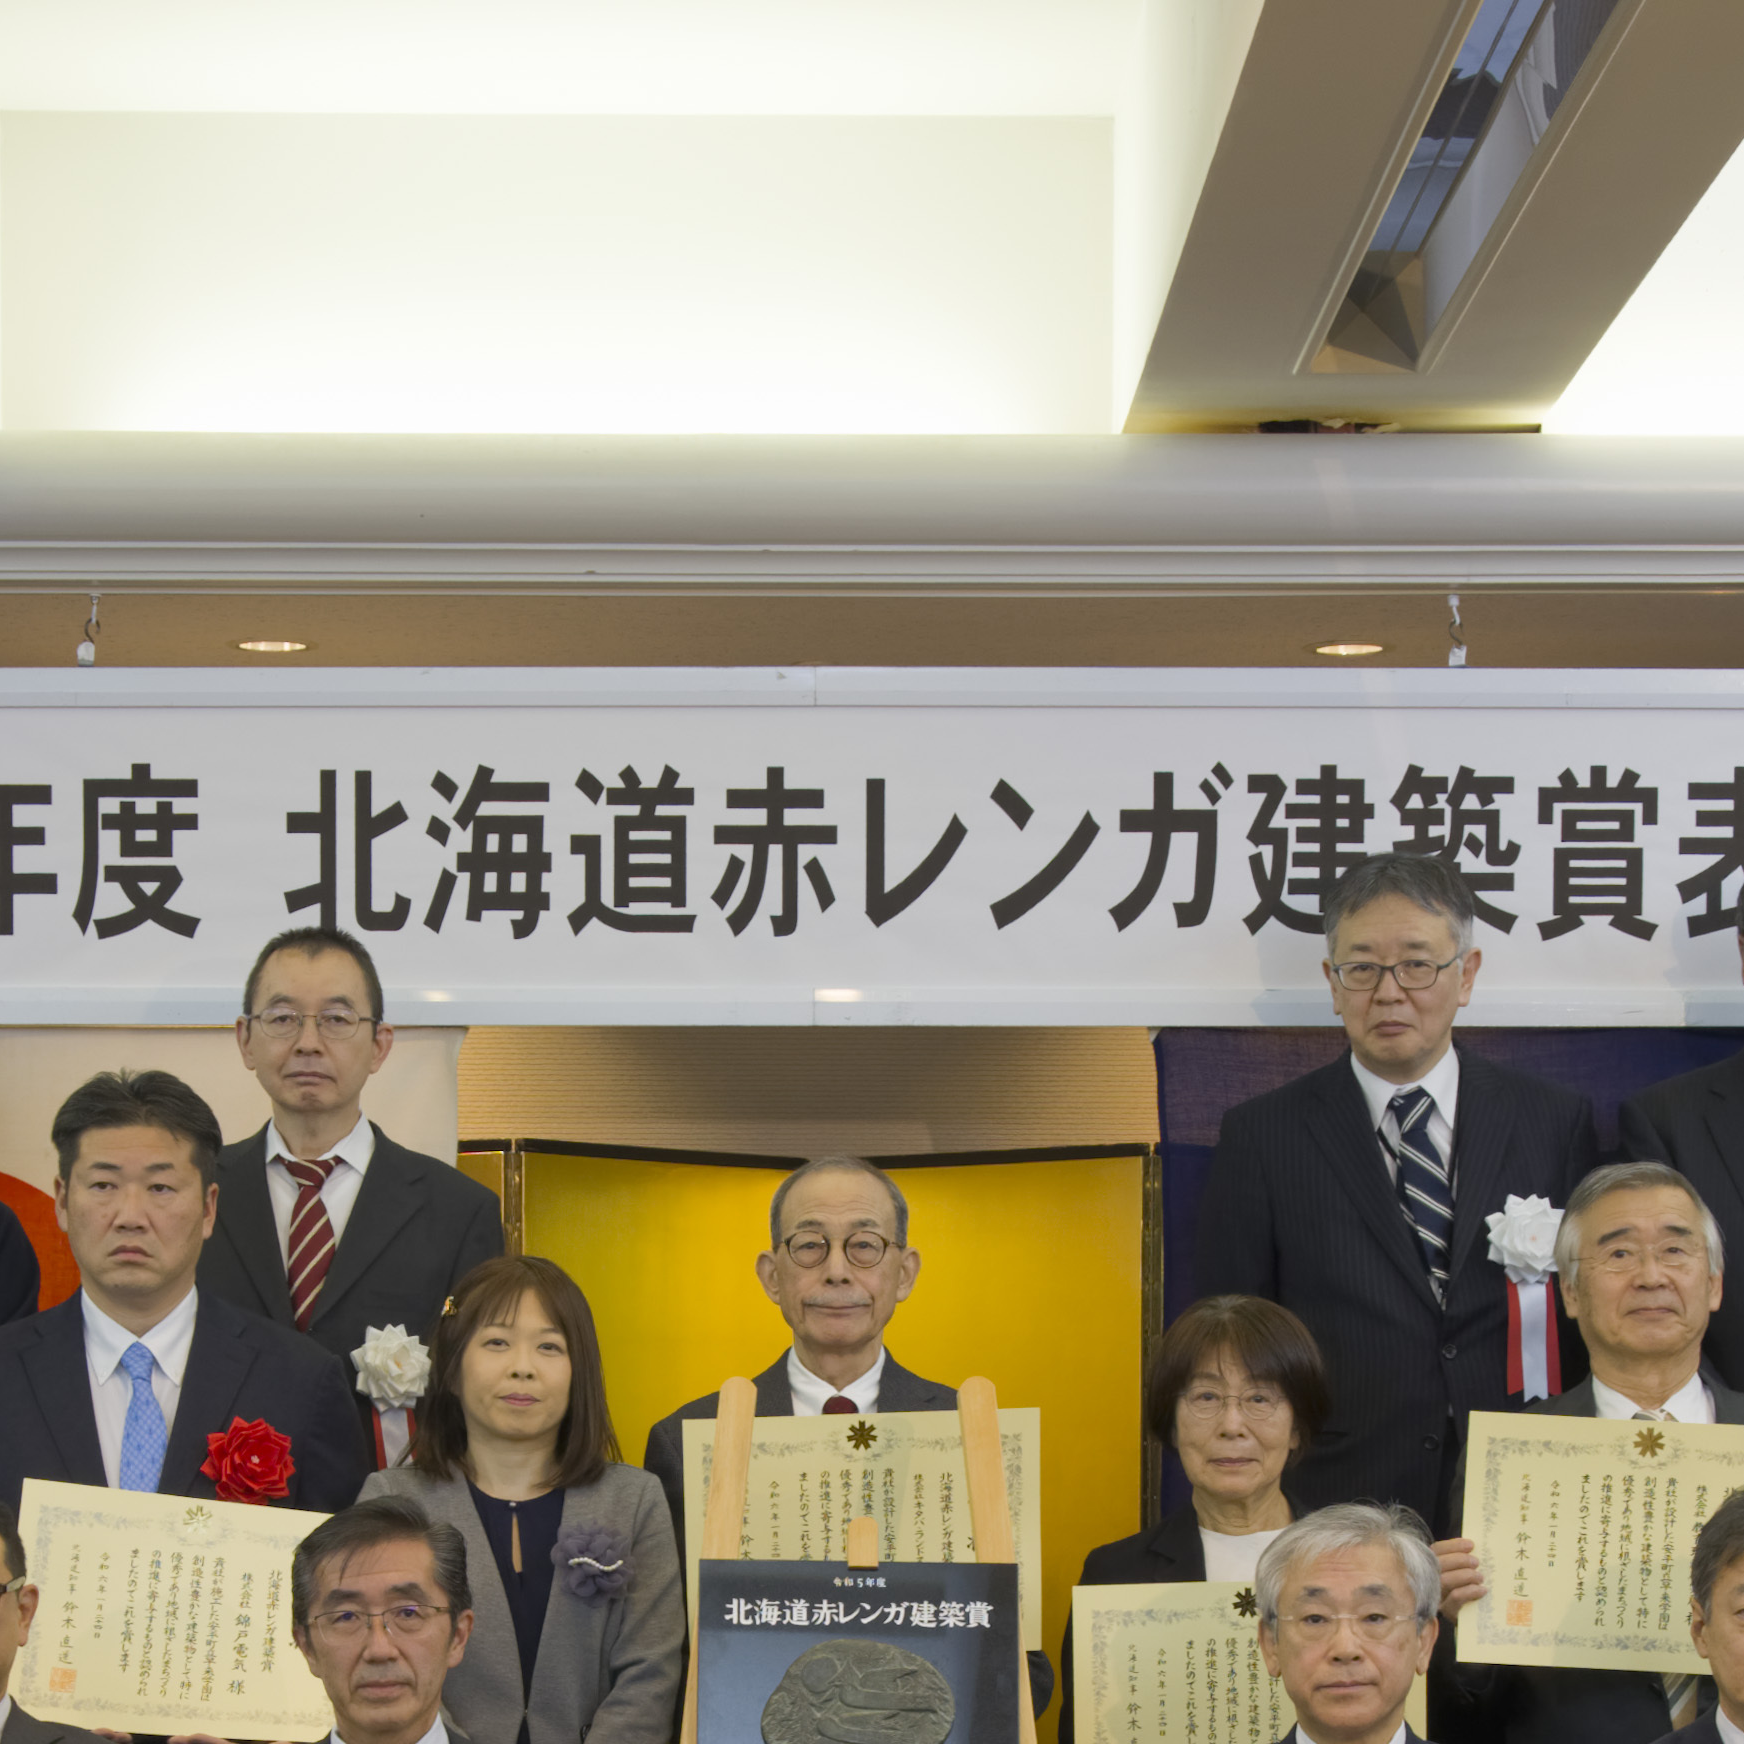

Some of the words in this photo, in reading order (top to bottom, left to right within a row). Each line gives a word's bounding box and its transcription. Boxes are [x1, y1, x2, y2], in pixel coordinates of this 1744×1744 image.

[833, 1577, 887, 1589] 令和5年度
[724, 1598, 994, 1629] 北海道赤レンガ建築賞
